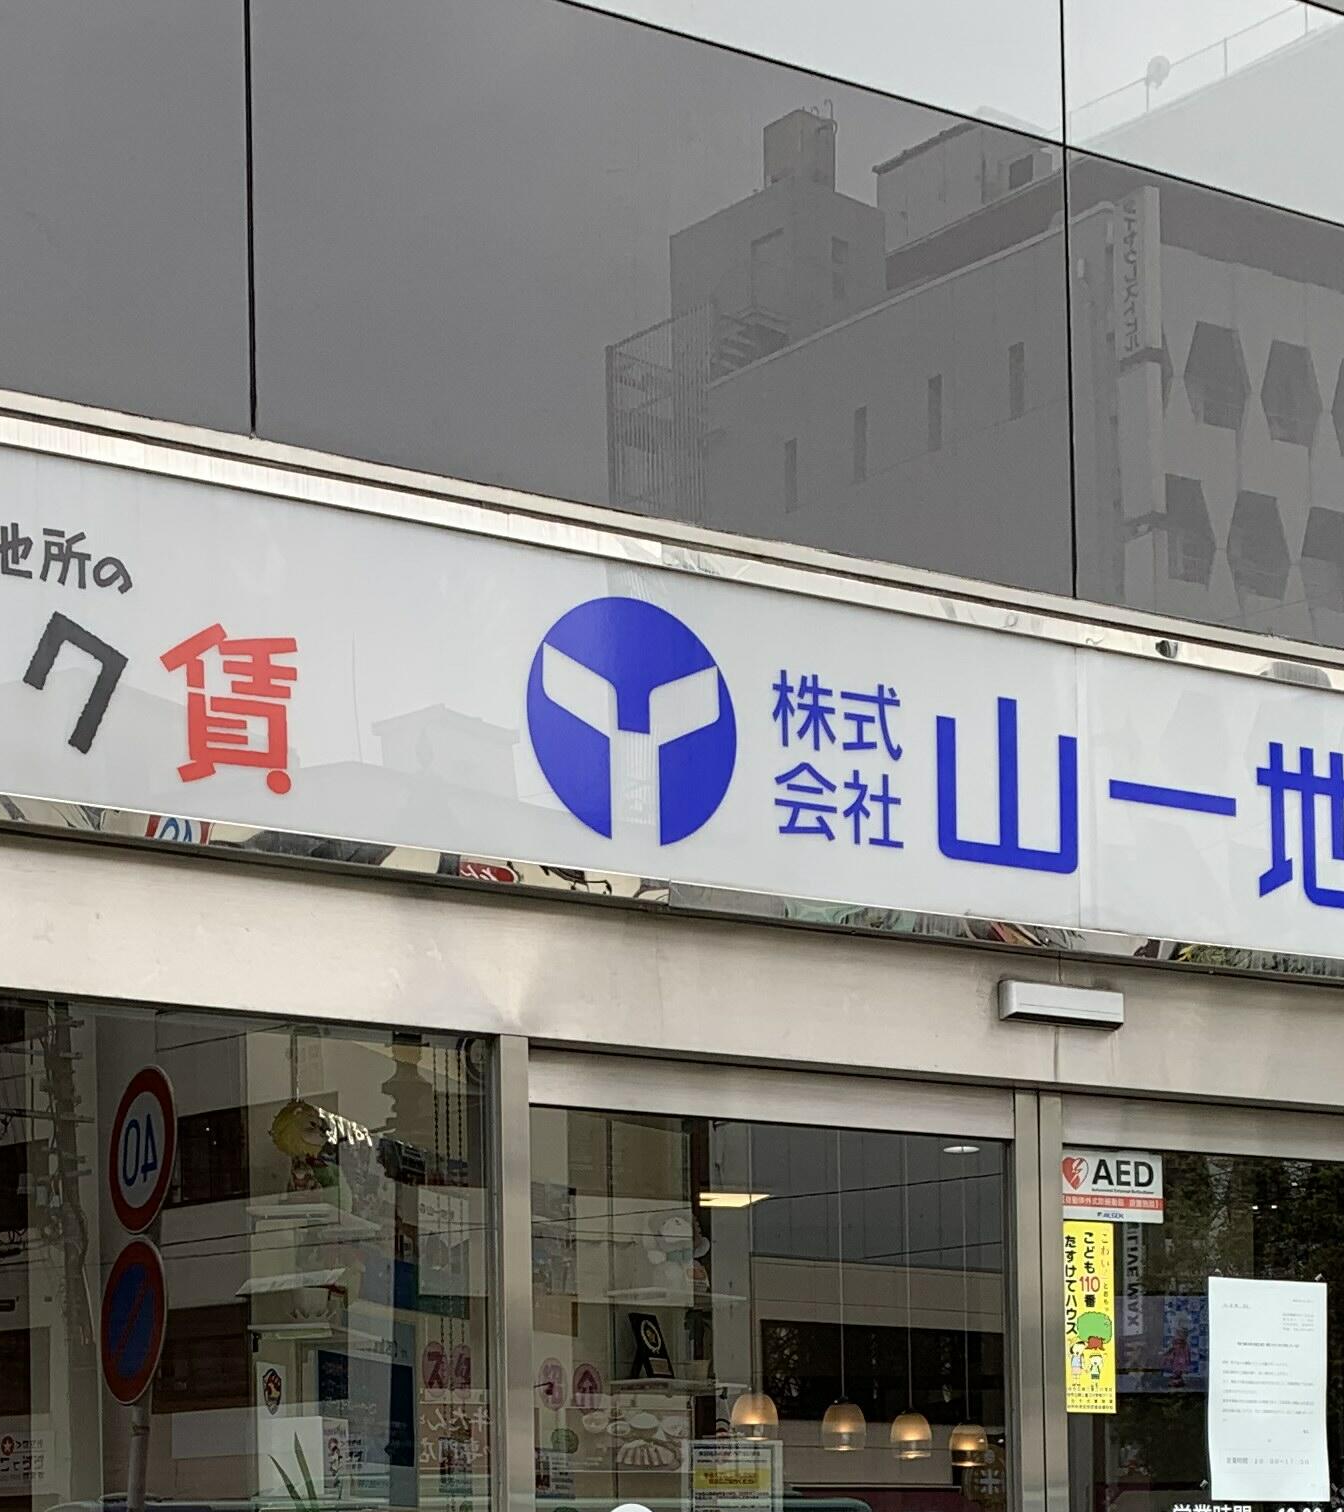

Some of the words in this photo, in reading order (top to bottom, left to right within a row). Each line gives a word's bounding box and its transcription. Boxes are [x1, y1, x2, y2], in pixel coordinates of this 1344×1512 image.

[771, 669, 903, 760] 株式
[773, 762, 904, 850] 会社
[1091, 1158, 1154, 1187] AED
[1064, 1235, 1078, 1335] たすけてハウス
[1079, 1231, 1101, 1308] こども110番
